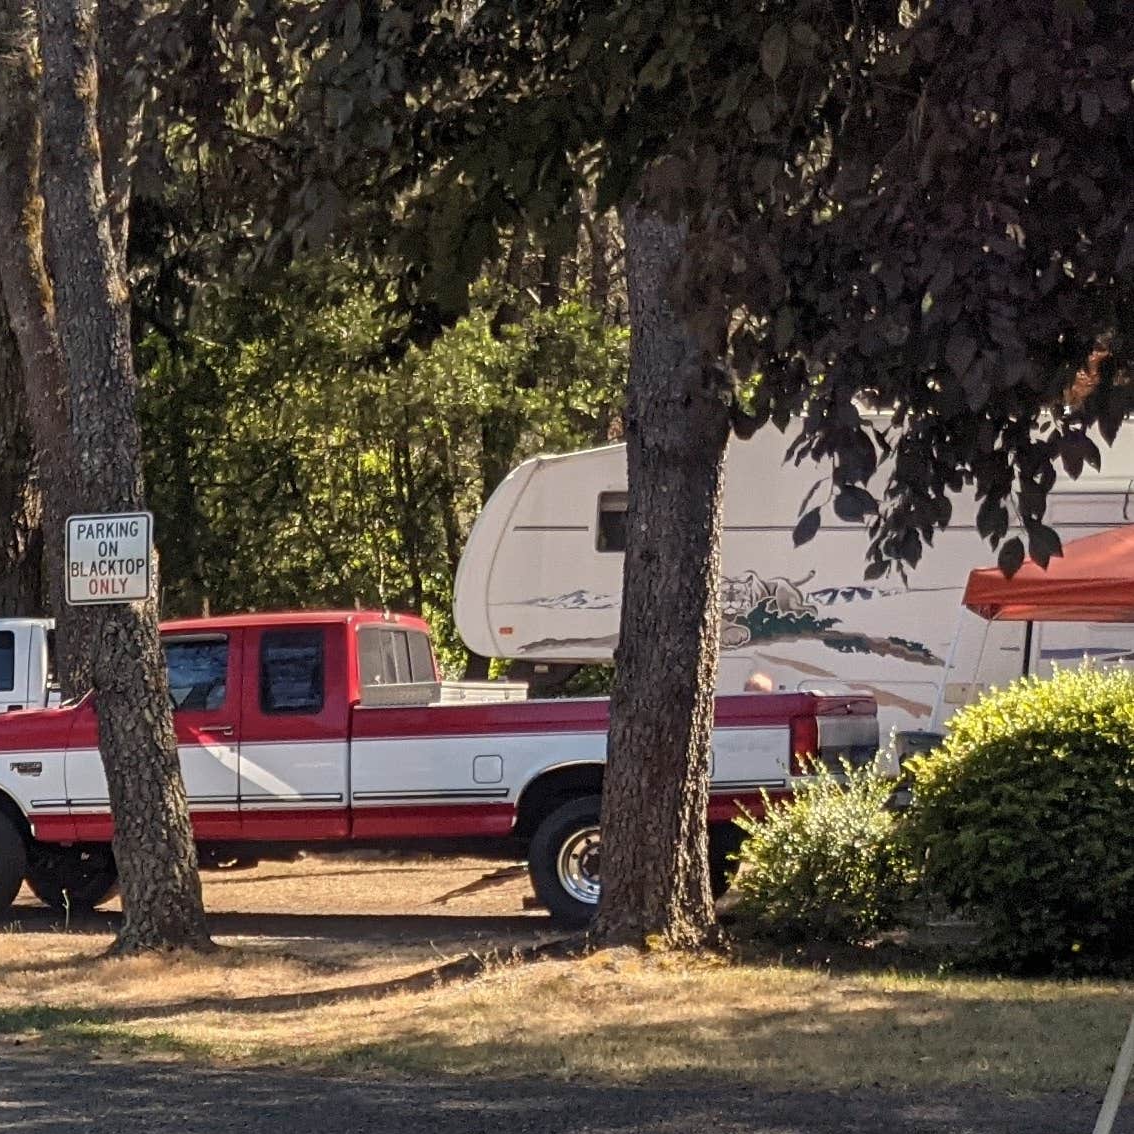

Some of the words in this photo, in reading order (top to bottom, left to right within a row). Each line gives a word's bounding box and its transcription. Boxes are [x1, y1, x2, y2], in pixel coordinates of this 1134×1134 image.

[77, 521, 139, 540] PARKING
[98, 541, 118, 557] ON
[71, 559, 145, 577] BLACKTOP
[89, 578, 128, 595] ONLY
